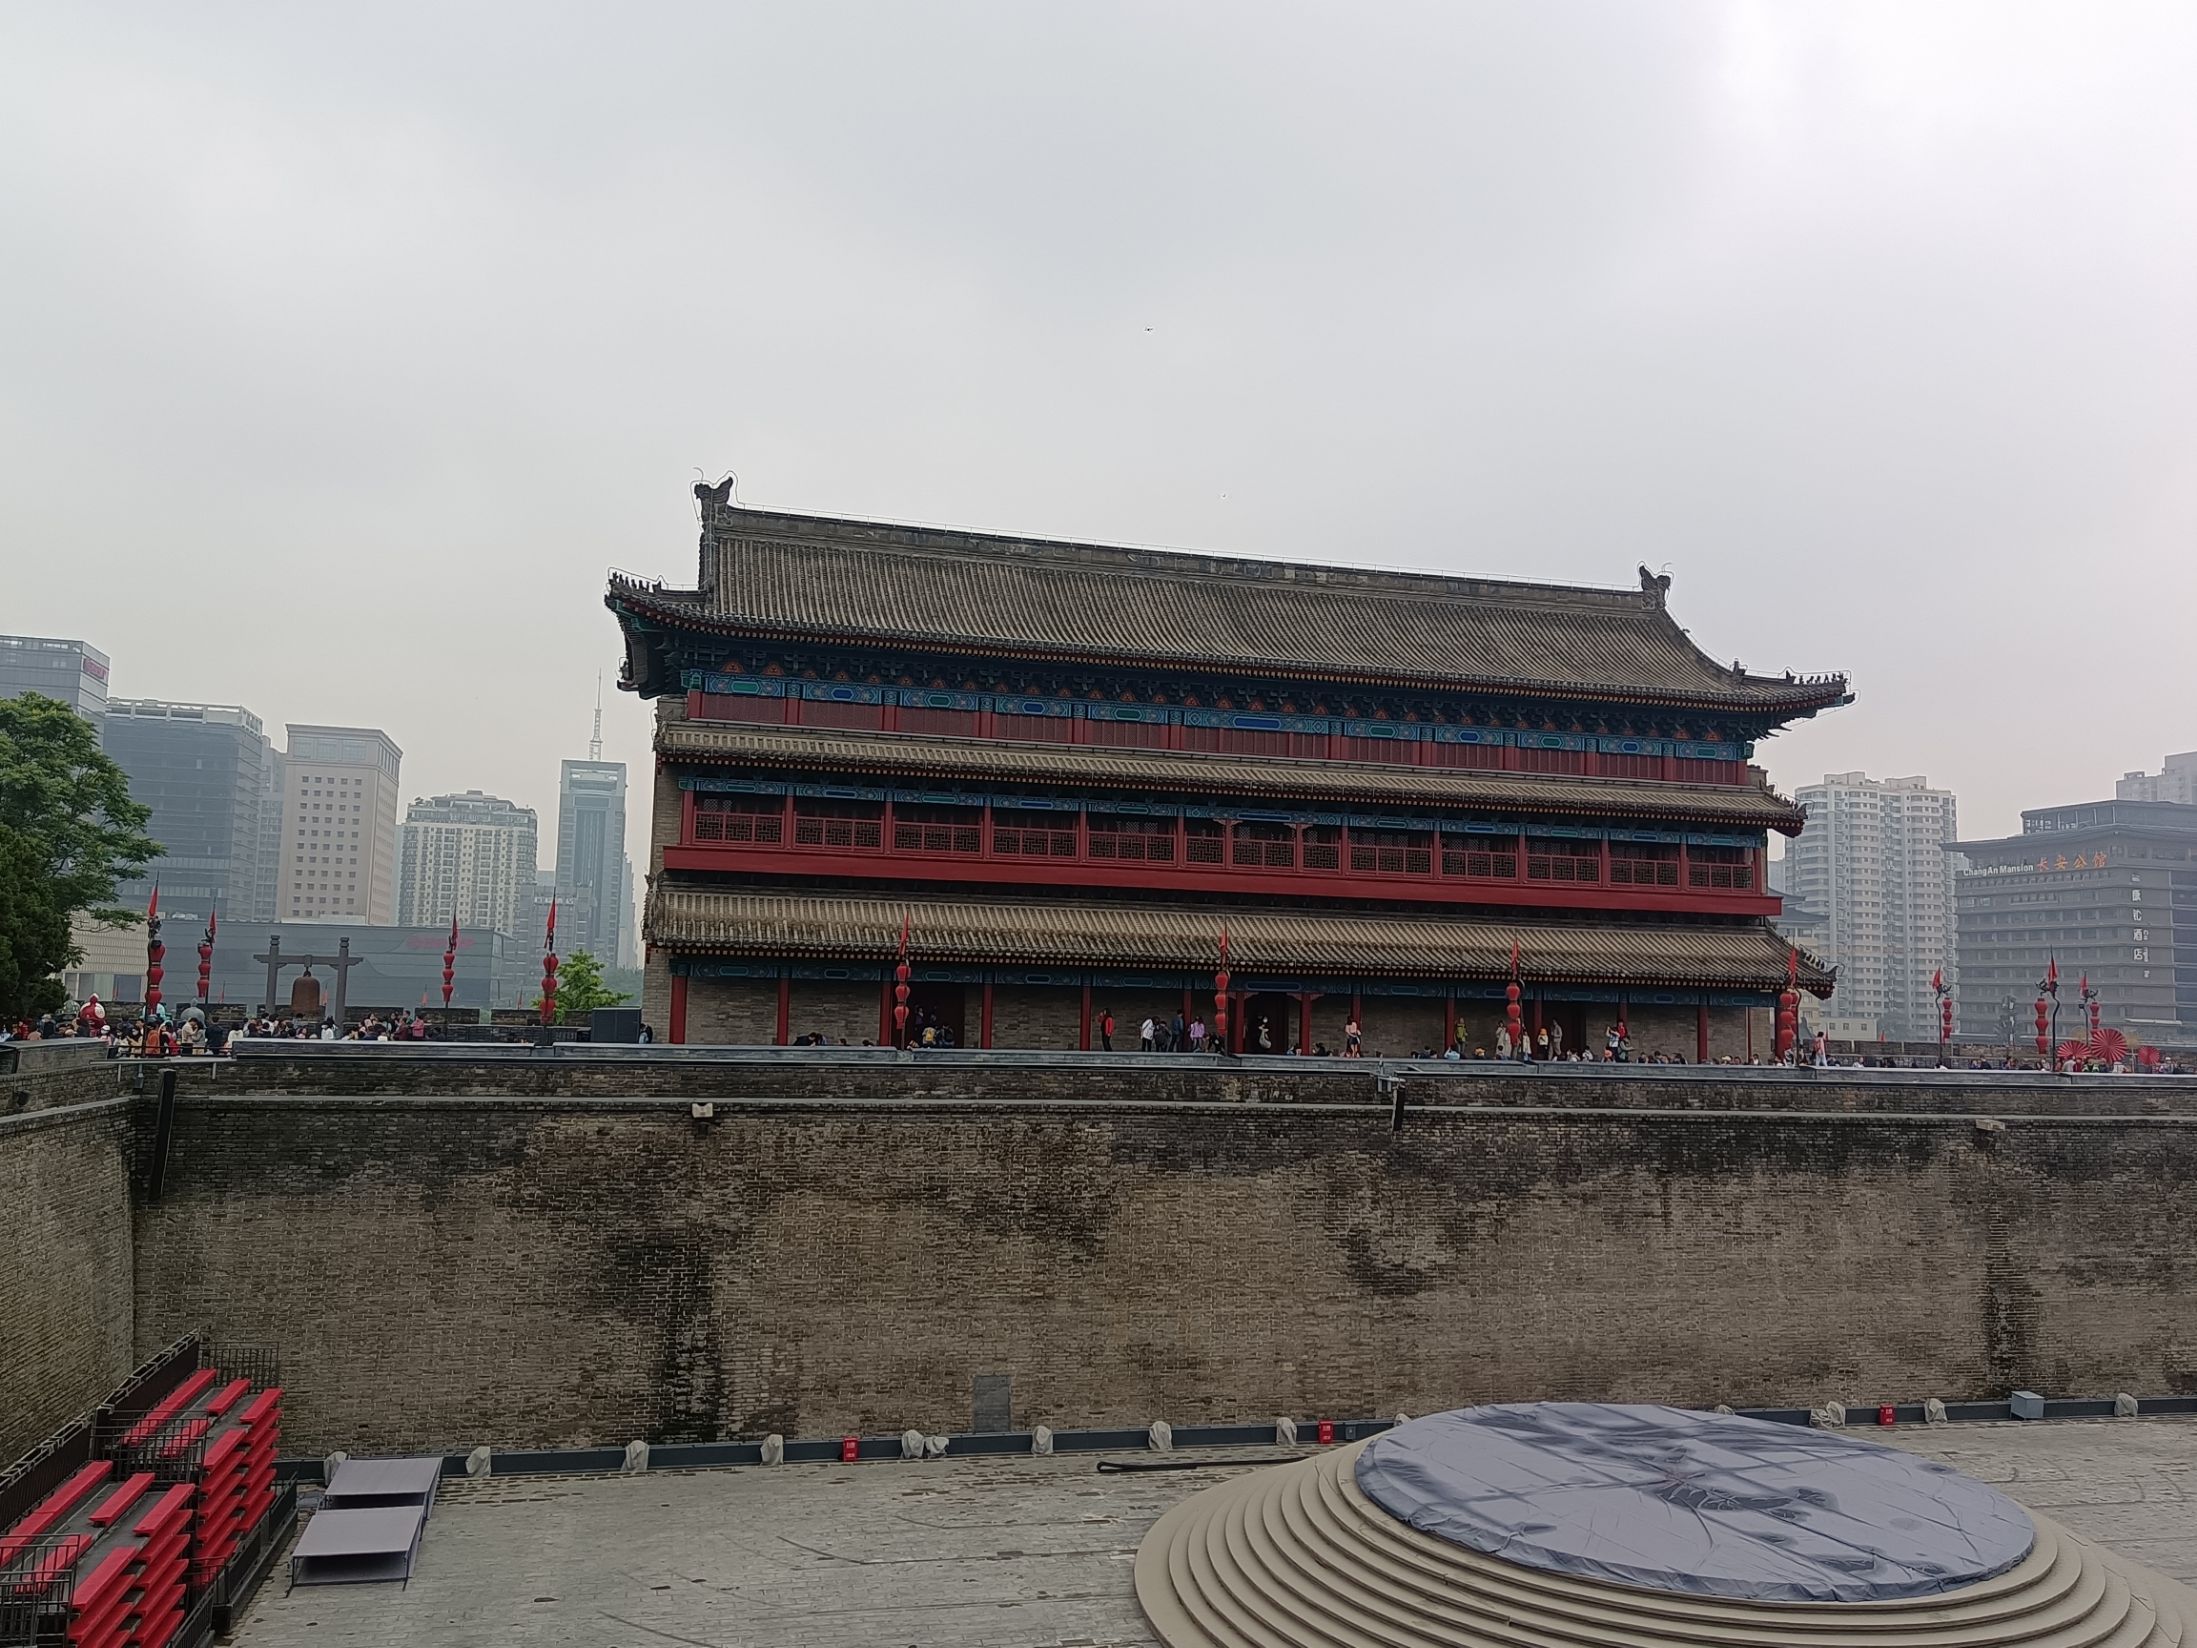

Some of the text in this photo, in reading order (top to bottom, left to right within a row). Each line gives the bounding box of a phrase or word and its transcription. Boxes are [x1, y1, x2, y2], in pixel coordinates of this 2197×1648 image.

[2036, 851, 2107, 871] 长安公馆
[1963, 863, 2034, 877] ChangAn Mansion
